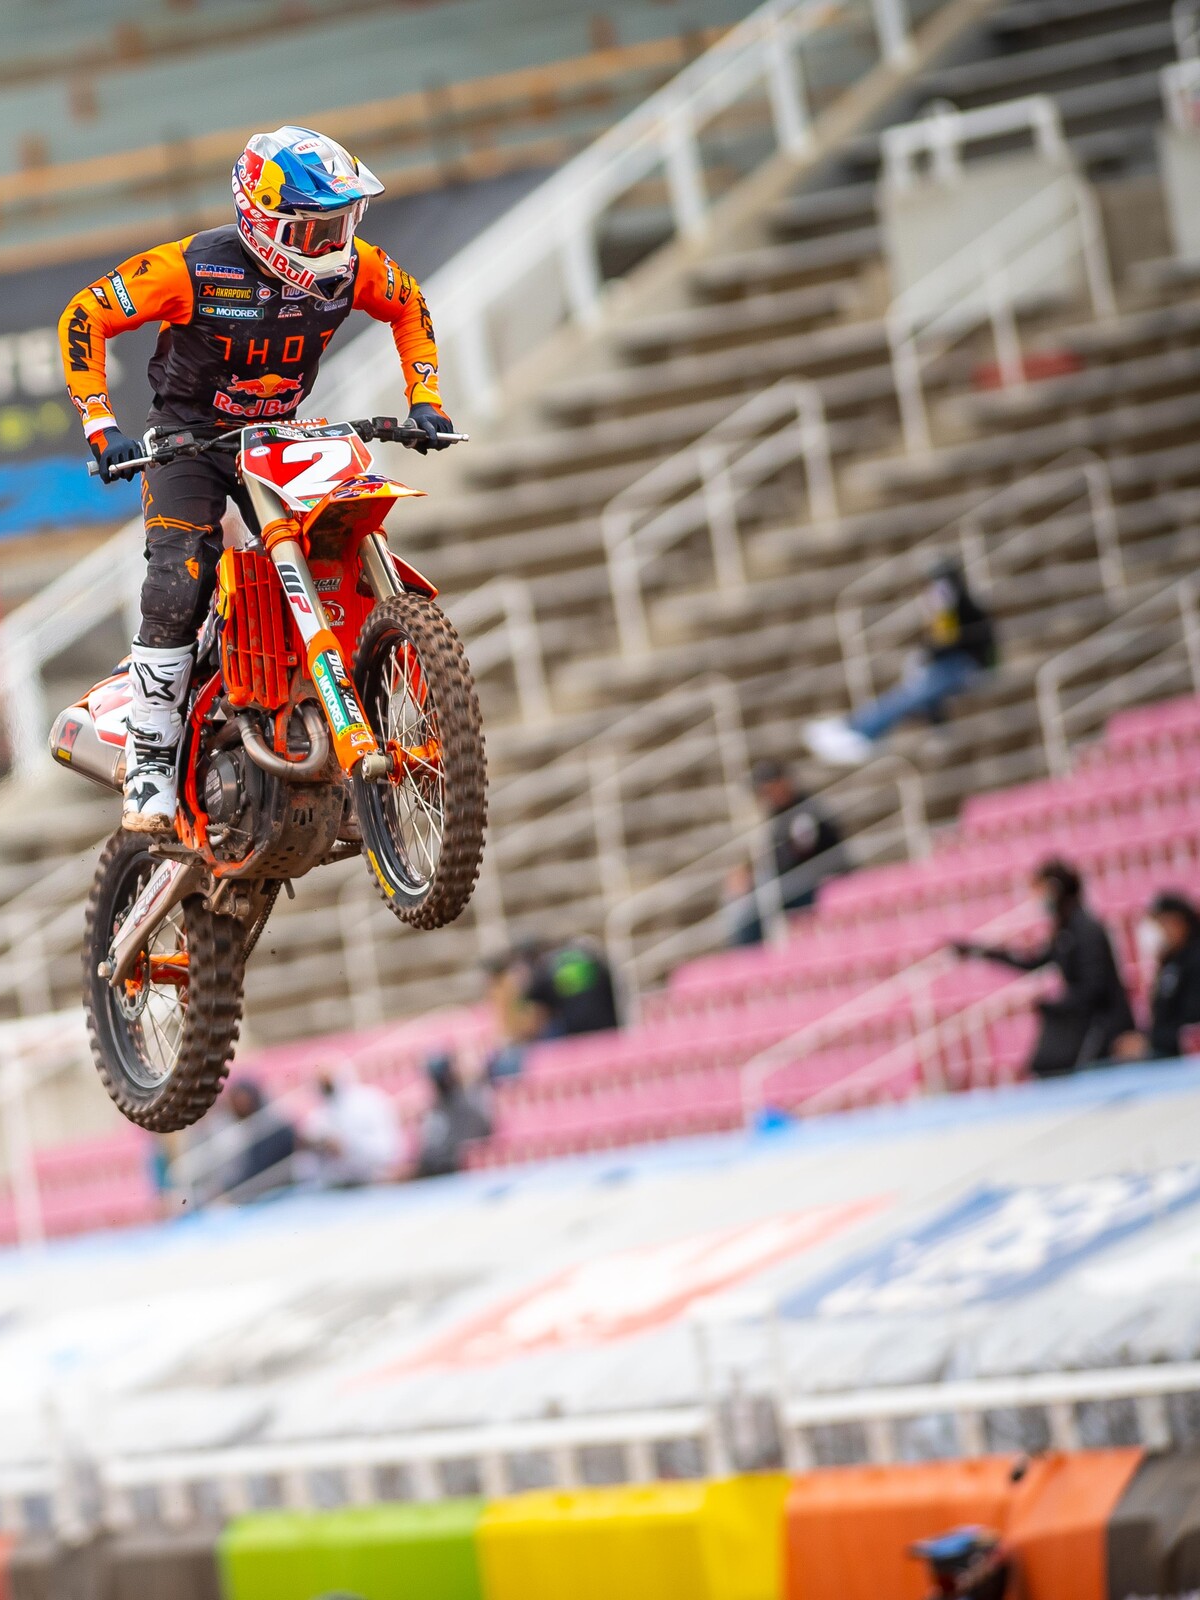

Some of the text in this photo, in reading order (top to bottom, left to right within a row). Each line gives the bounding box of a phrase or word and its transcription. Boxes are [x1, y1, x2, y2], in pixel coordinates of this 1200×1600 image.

[297, 141, 321, 152] BELL
[241, 217, 317, 289] Red Bull
[68, 306, 93, 372] KTM
[216, 307, 259, 318] MOTOREX
[213, 388, 305, 418] Red Bull
[282, 439, 353, 500] 2
[318, 674, 347, 733] MOTOREX
